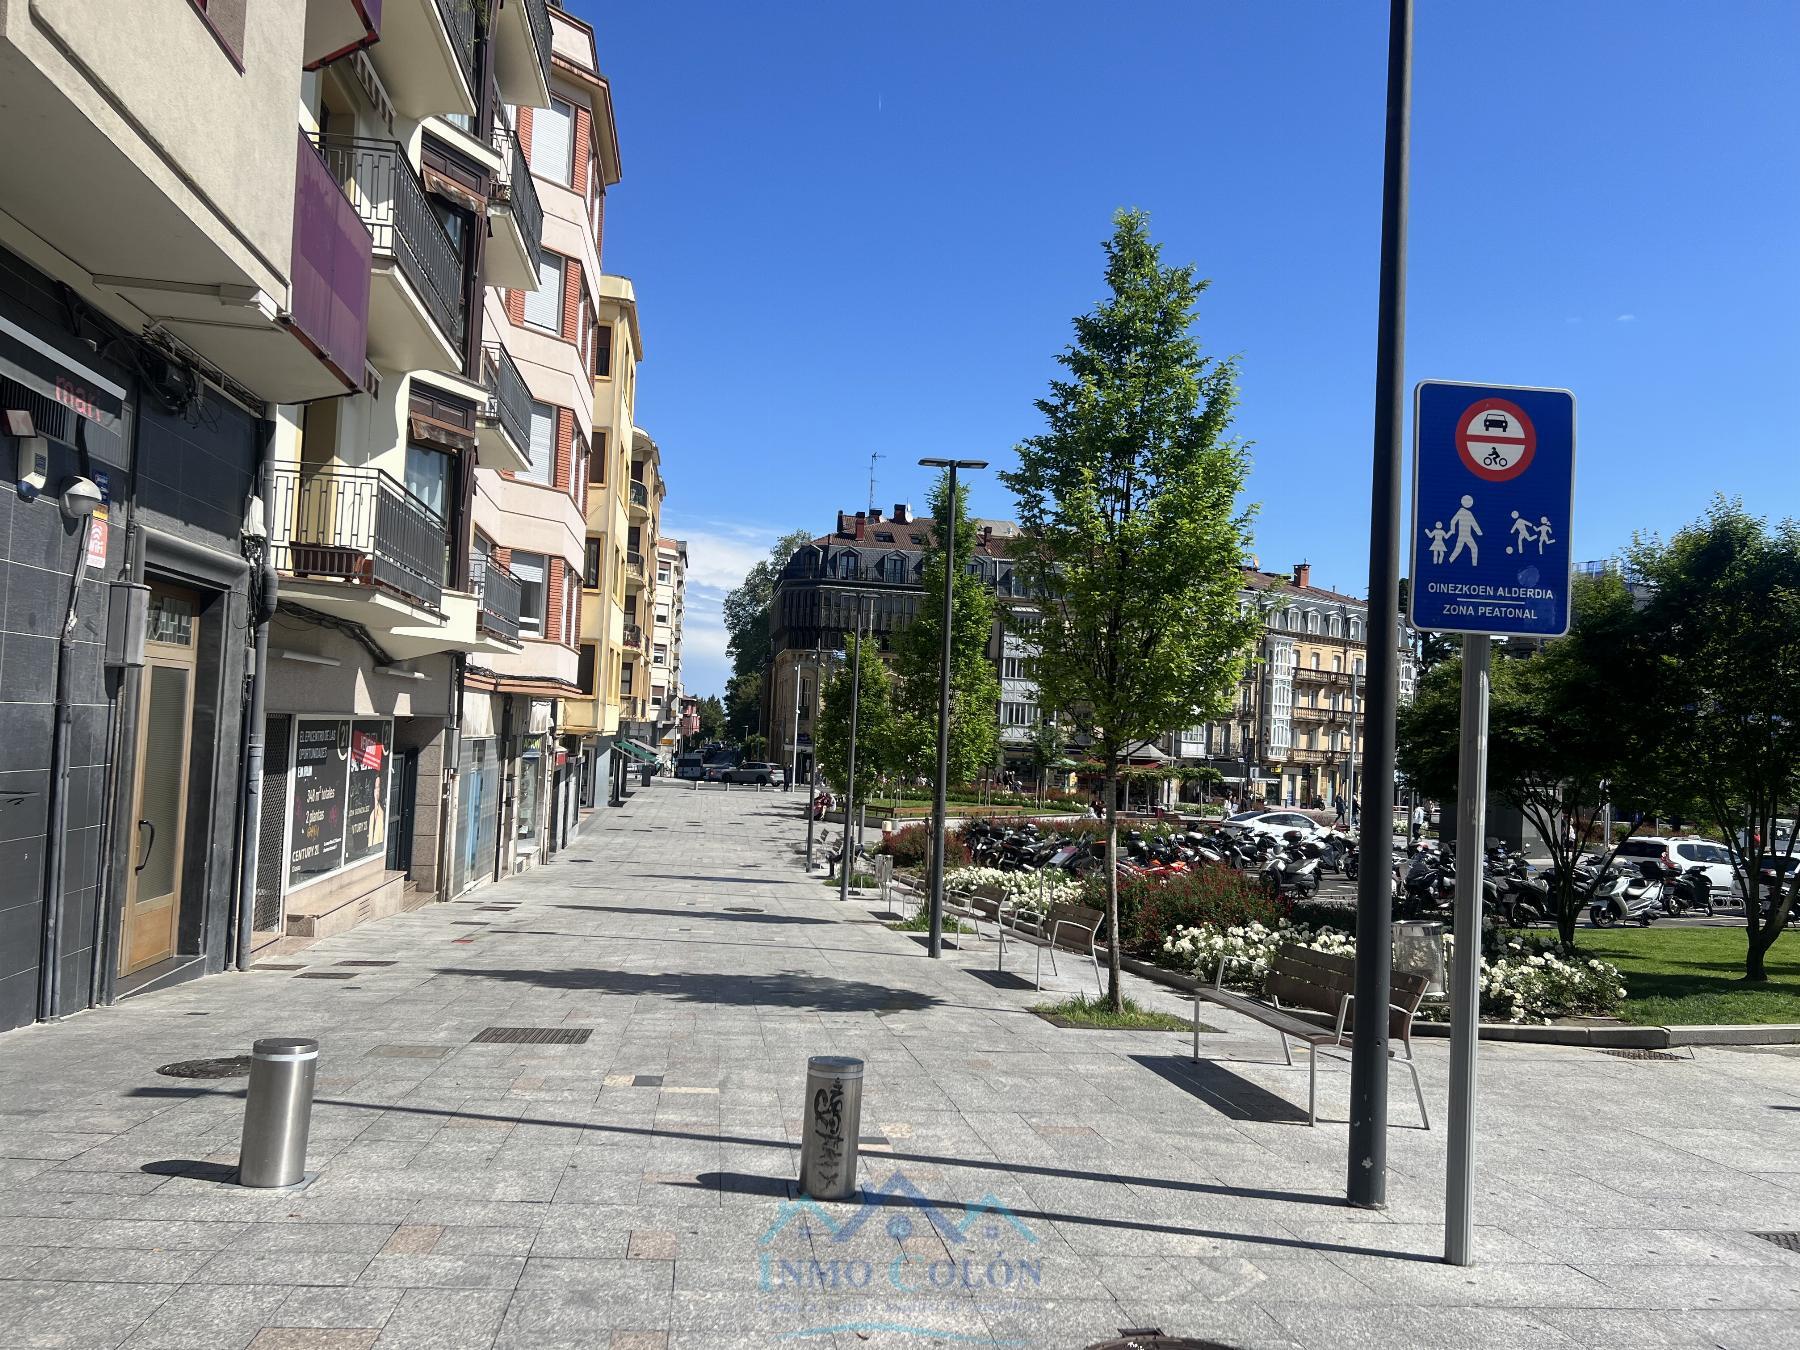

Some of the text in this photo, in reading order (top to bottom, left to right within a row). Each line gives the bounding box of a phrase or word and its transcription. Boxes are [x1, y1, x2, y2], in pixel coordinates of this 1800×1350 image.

[1428, 582, 1554, 599] OINEZKOEN ALDERDIA
[1443, 604, 1538, 619] ZONA PEATONAL
[292, 845, 315, 862] CENTURY
